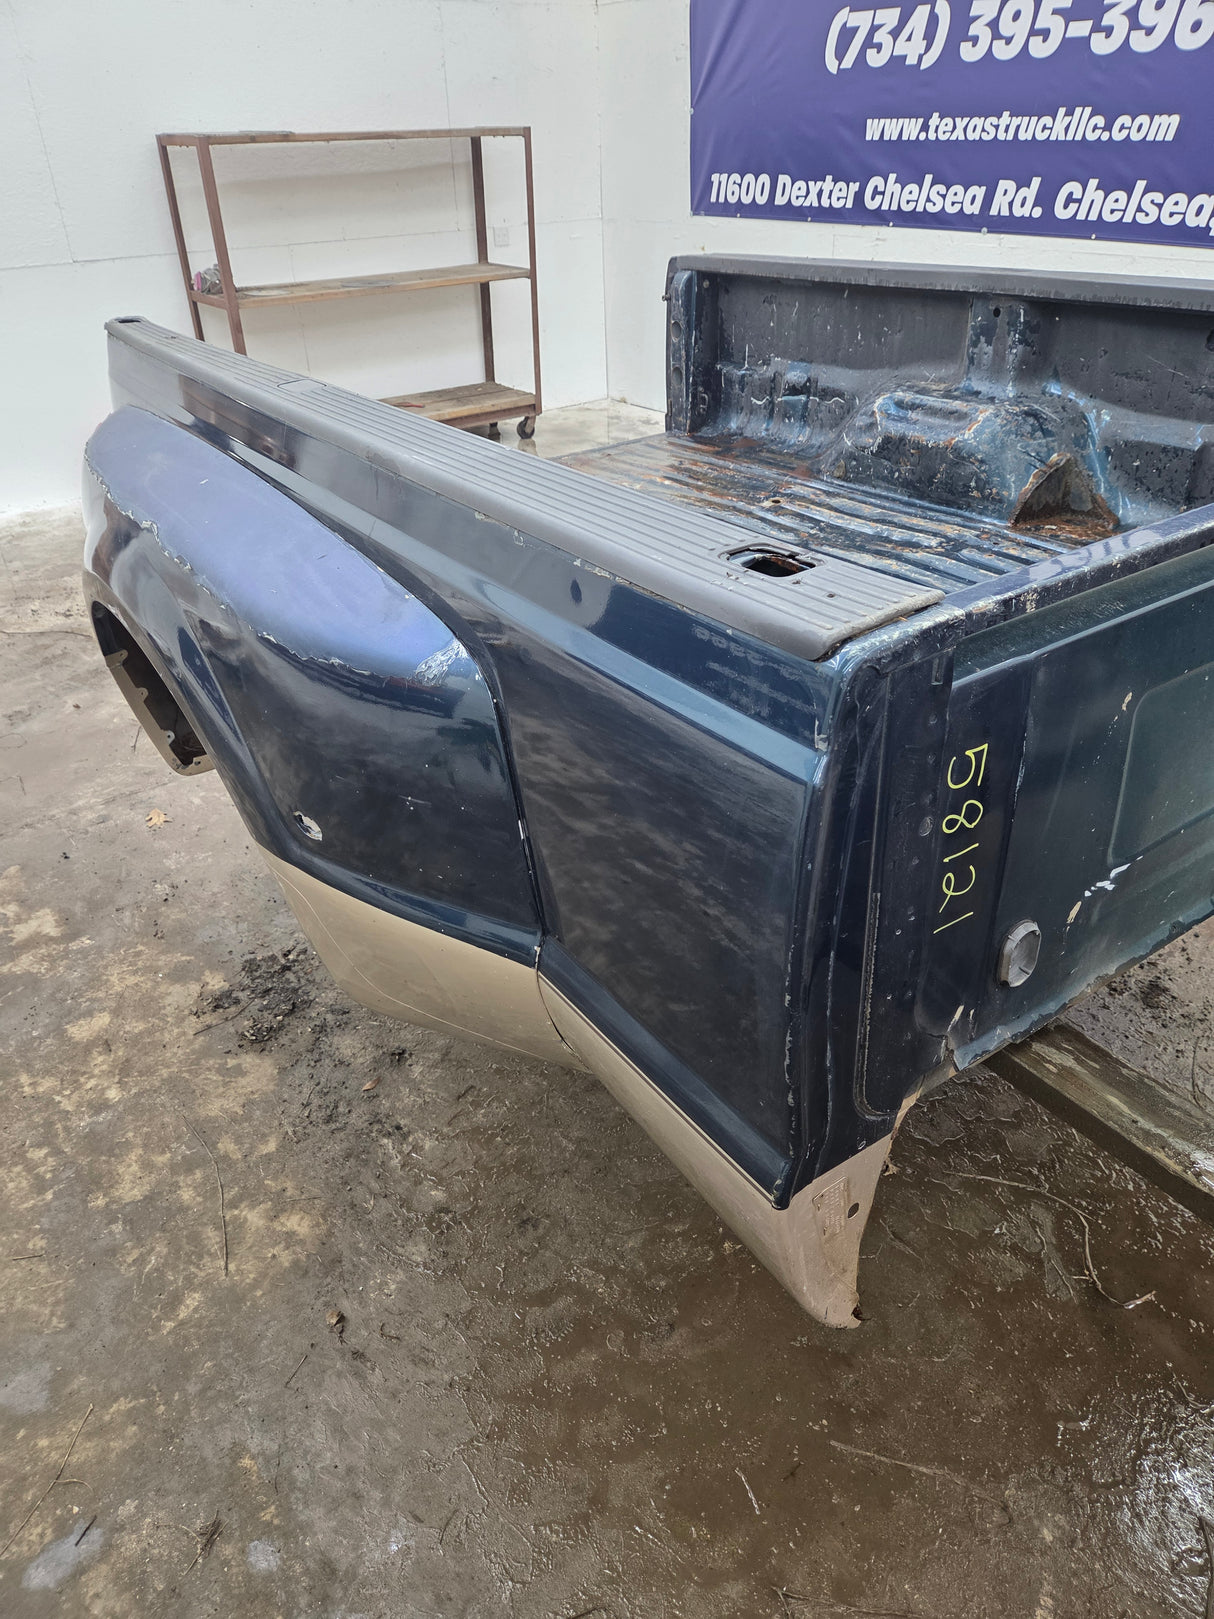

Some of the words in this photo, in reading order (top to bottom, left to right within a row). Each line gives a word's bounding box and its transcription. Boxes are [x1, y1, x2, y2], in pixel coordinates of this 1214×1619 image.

[824, 0, 951, 75] (734)
[865, 106, 1181, 142] www.texastruckllc.com
[710, 172, 771, 205] 11600
[774, 174, 860, 210] Dexter
[864, 173, 985, 216] Chelsea
[988, 176, 1044, 220] Rd.
[1053, 177, 1214, 237] Chelsea,
